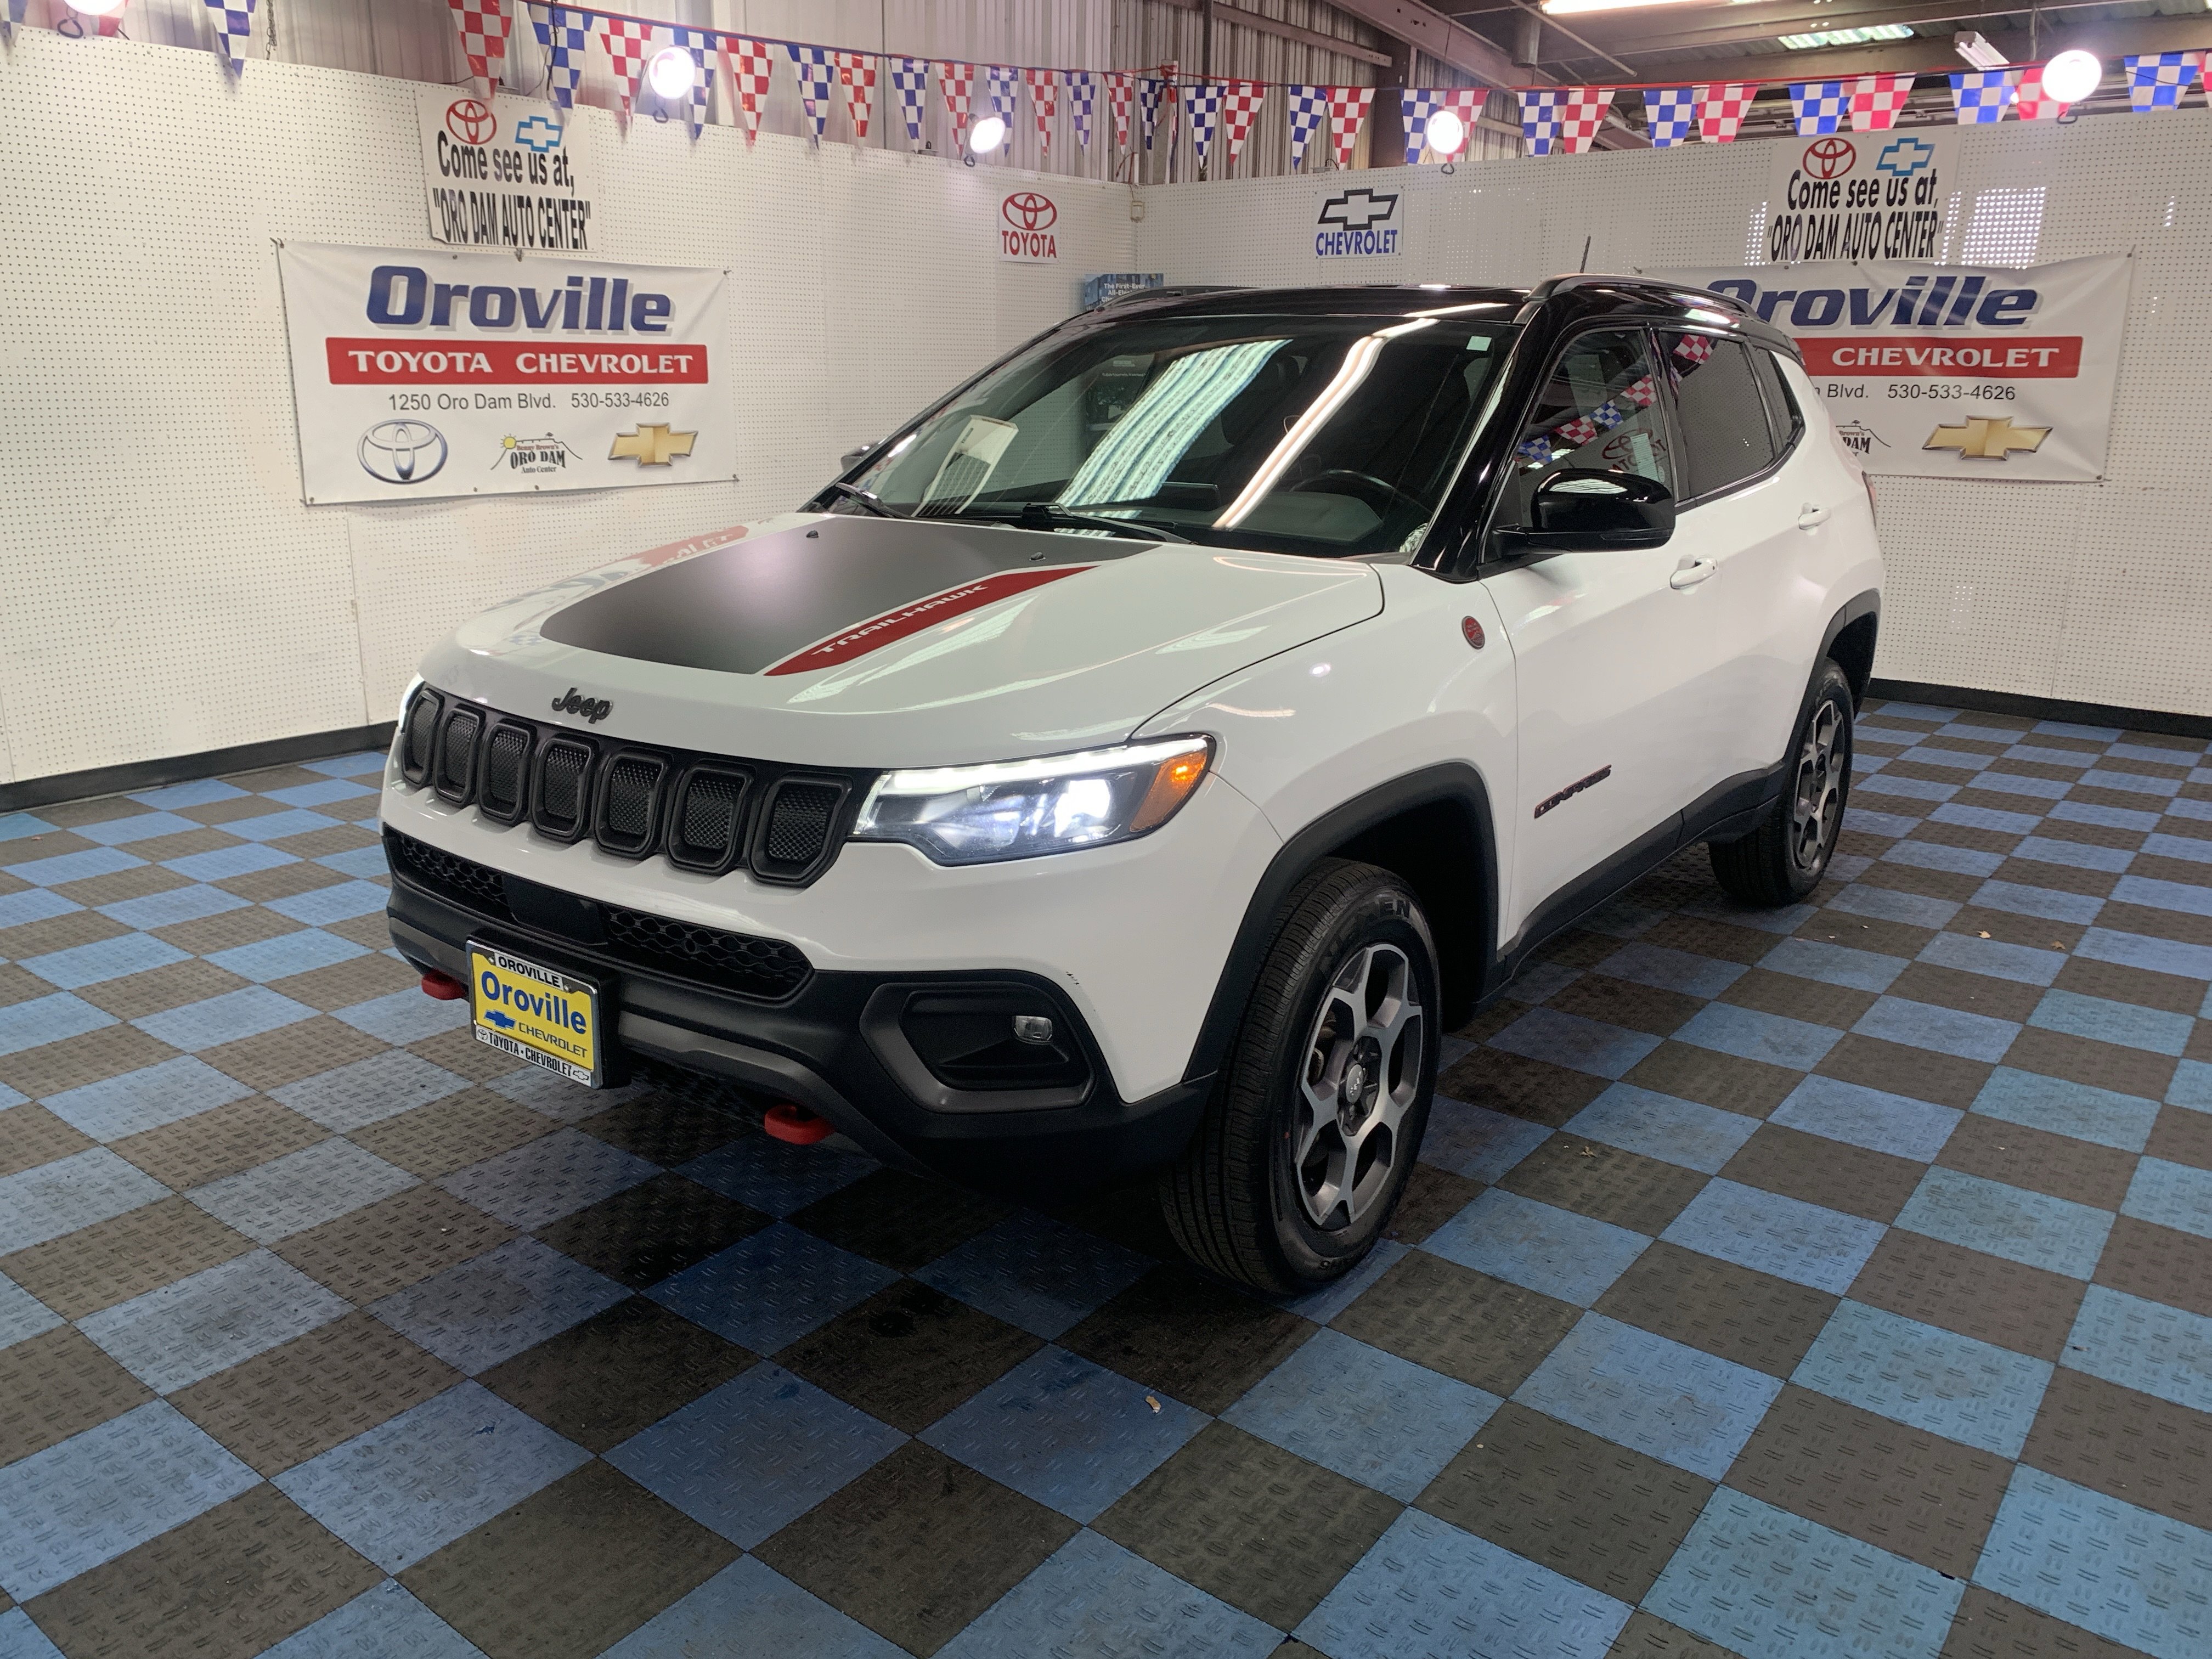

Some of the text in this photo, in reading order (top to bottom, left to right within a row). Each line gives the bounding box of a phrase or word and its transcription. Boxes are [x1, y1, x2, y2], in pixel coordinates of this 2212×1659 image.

[438, 131, 574, 198] Come see us at,
[1788, 168, 1938, 210] Come see us at,
[470, 191, 499, 245] DAM
[502, 194, 534, 247] AUTO
[1804, 213, 1839, 260] DAM
[1840, 211, 1882, 260] AUTO
[1002, 230, 1057, 258] TOYOTA
[1316, 229, 1398, 256] CHEVROLET
[366, 264, 673, 332] Oroville
[348, 351, 693, 374] TOYOTA CHEVROLET
[1832, 347, 2059, 368] CHEVROLET
[388, 392, 670, 411] 1250 Oro Dam Blvd. 530-533-4626
[1827, 383, 1869, 399] Blvd.
[1887, 384, 2016, 401] 530-533-4626
[510, 450, 566, 469] ORO DAM
[810, 584, 989, 656] TRAILHAWK
[551, 687, 613, 724] Jeep
[498, 956, 561, 988] OROVILLE
[481, 970, 587, 1035] Oroville
[488, 1031, 572, 1077] TOYOTA CHEVROLET
[518, 1022, 588, 1058] CHEVROLET
